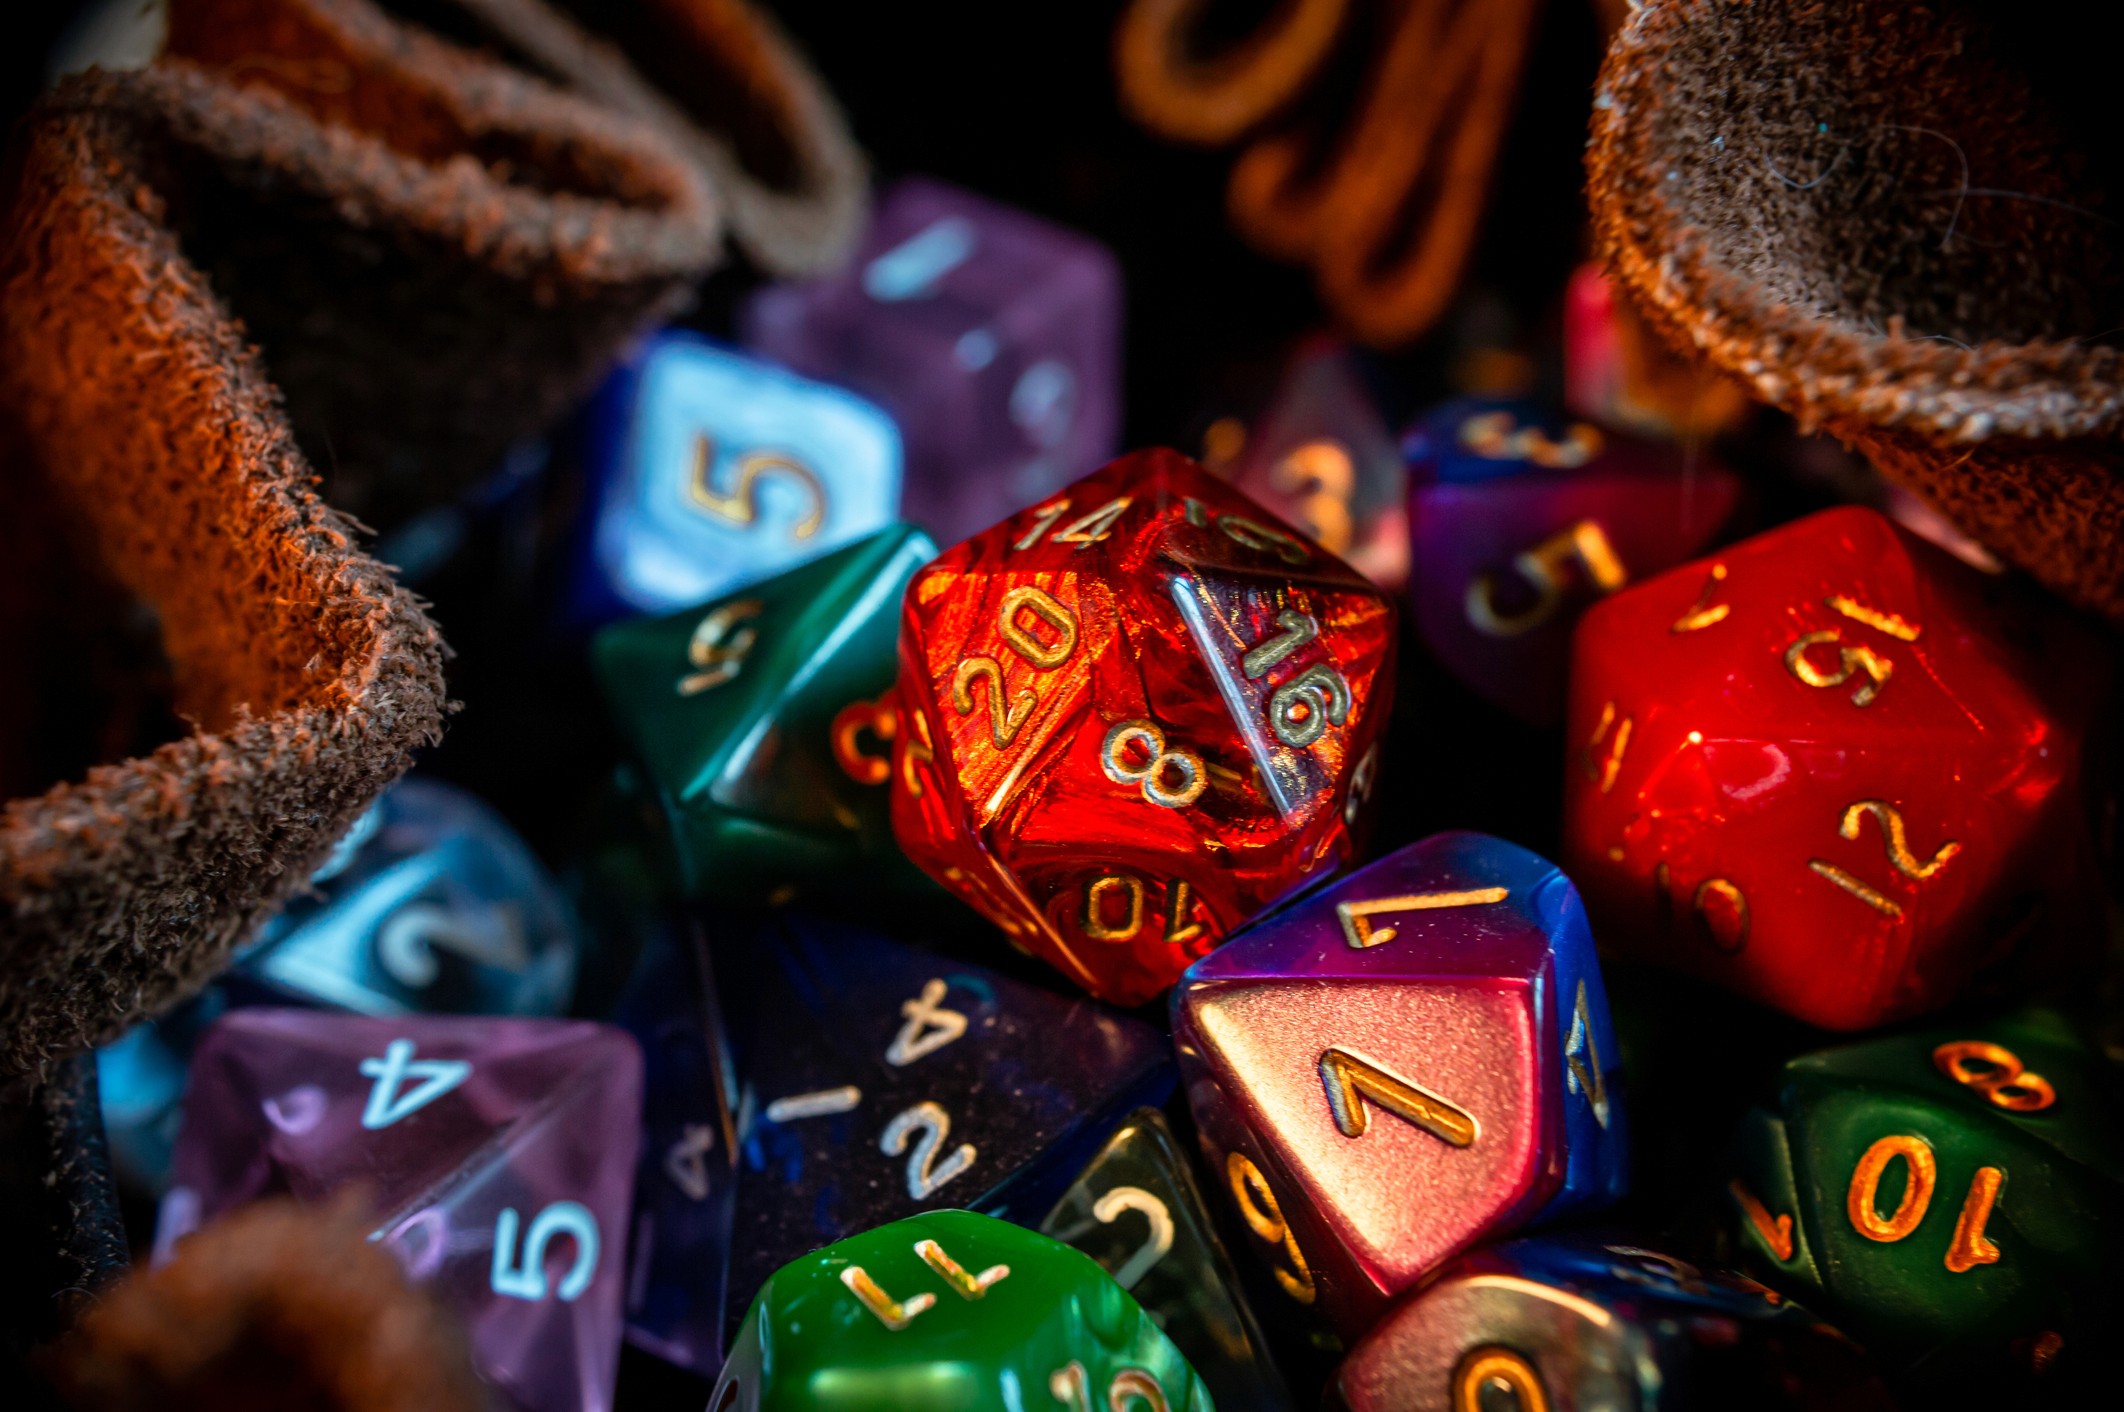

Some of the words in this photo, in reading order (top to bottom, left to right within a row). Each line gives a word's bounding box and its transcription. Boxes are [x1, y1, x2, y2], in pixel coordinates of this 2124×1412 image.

[687, 433, 826, 539] 5
[1013, 498, 1133, 550] 14
[1465, 520, 1627, 636] 5
[953, 585, 1079, 750] 20
[1242, 609, 1353, 748] 16
[1102, 718, 1206, 808] 8
[1808, 799, 1963, 918] 12
[1082, 876, 1201, 943] 10
[886, 977, 968, 1067] 4
[359, 1037, 475, 1130] 4
[1932, 1040, 2056, 1112] 8
[880, 1101, 977, 1201] 2
[491, 1200, 601, 1302] 5
[1846, 1135, 2002, 1274] 10
